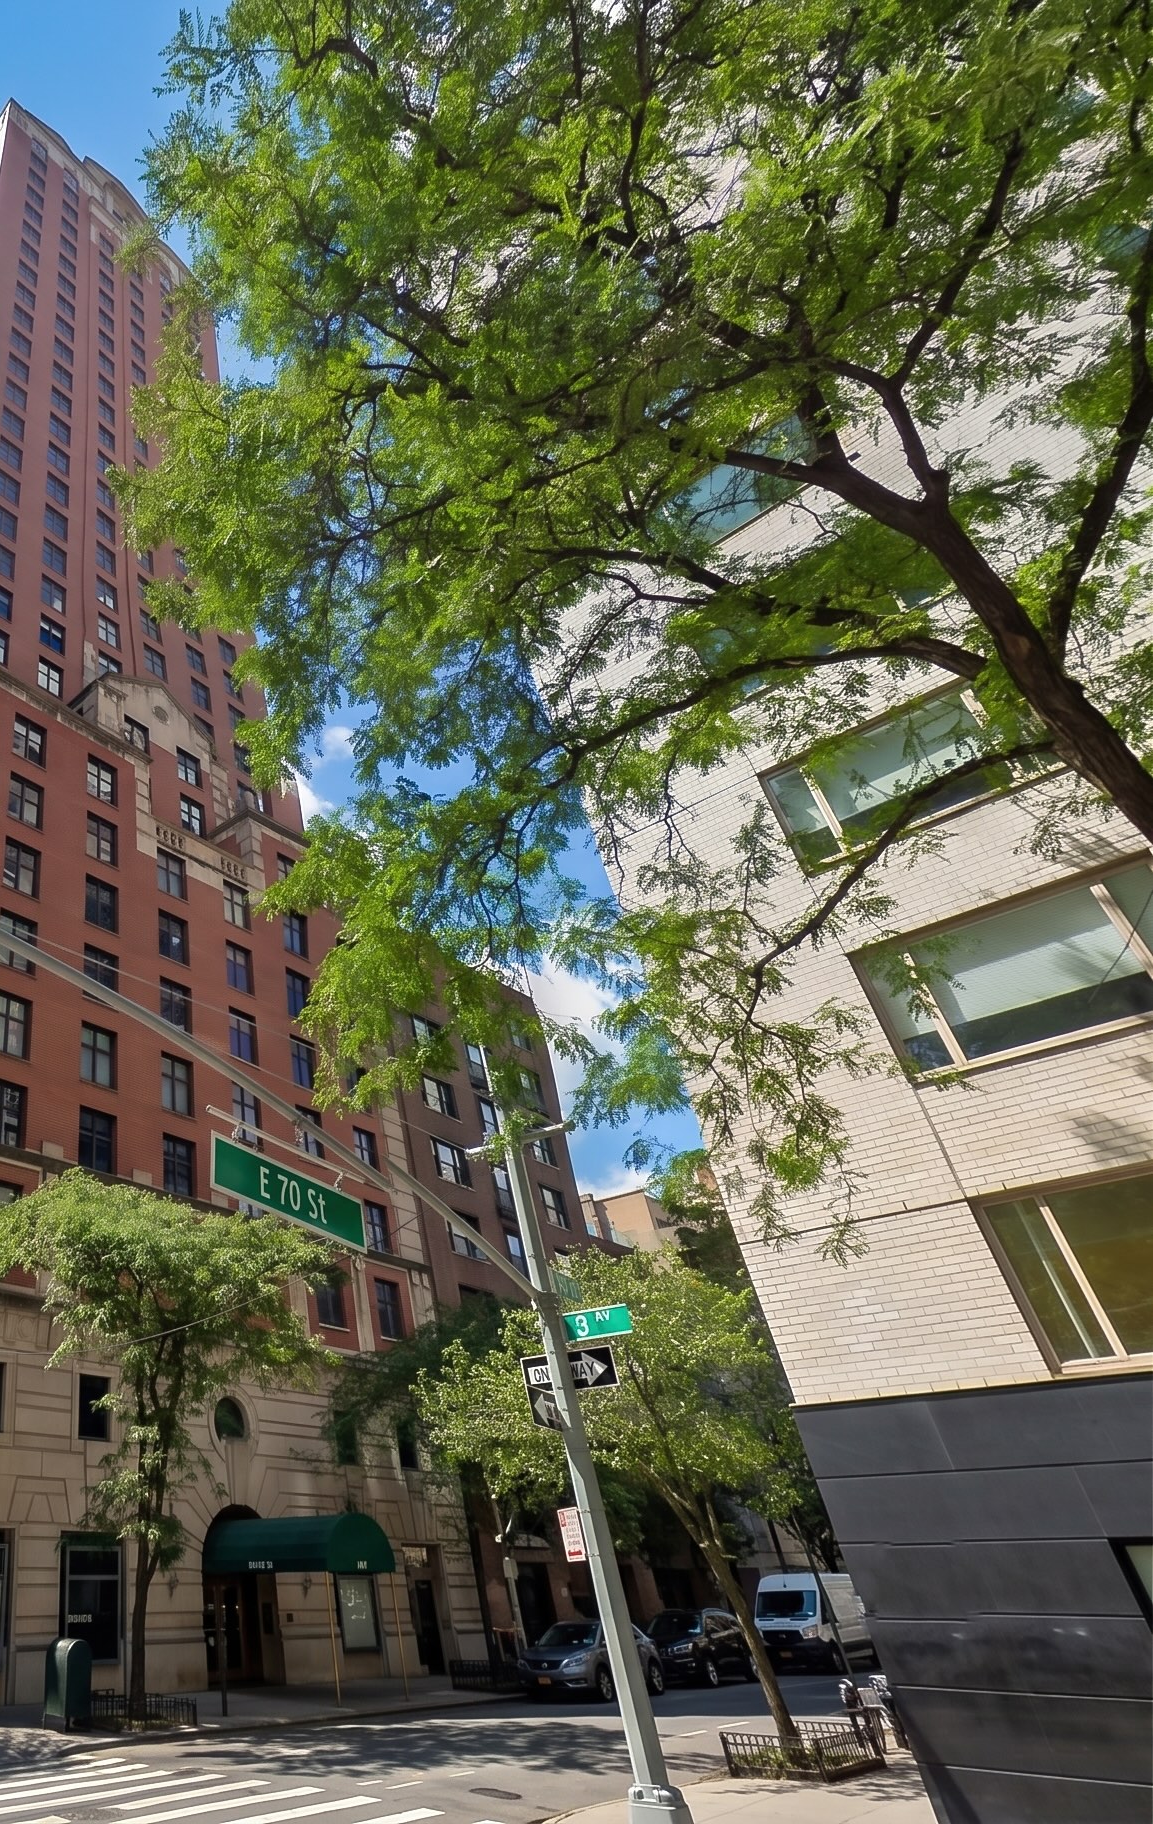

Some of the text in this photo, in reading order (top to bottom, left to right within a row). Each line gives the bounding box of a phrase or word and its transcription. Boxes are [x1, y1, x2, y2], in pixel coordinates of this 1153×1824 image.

[259, 1166, 328, 1225] E 70 St
[575, 1310, 611, 1337] 3 AV
[533, 1361, 595, 1383] ON WAY
